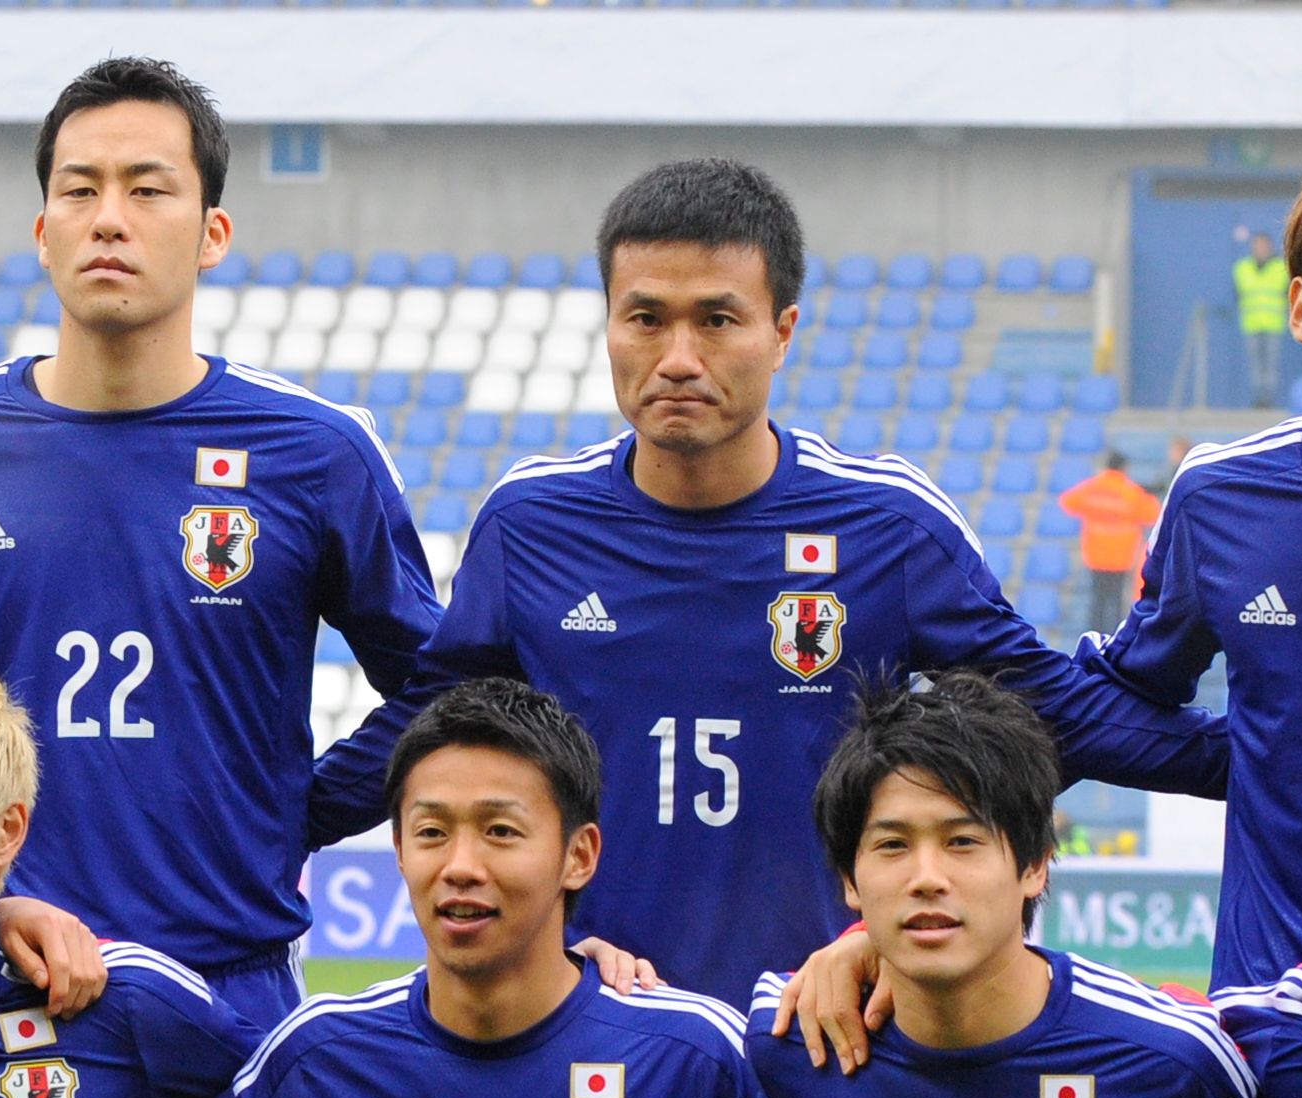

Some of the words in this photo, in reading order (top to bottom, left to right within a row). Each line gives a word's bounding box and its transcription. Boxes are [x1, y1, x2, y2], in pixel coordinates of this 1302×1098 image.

[189, 595, 243, 606] JAPAN
[560, 616, 617, 633] adidas
[1239, 608, 1297, 626] adidas
[55, 630, 155, 739] 22
[778, 685, 832, 694] JAPAN
[648, 717, 741, 827] 15
